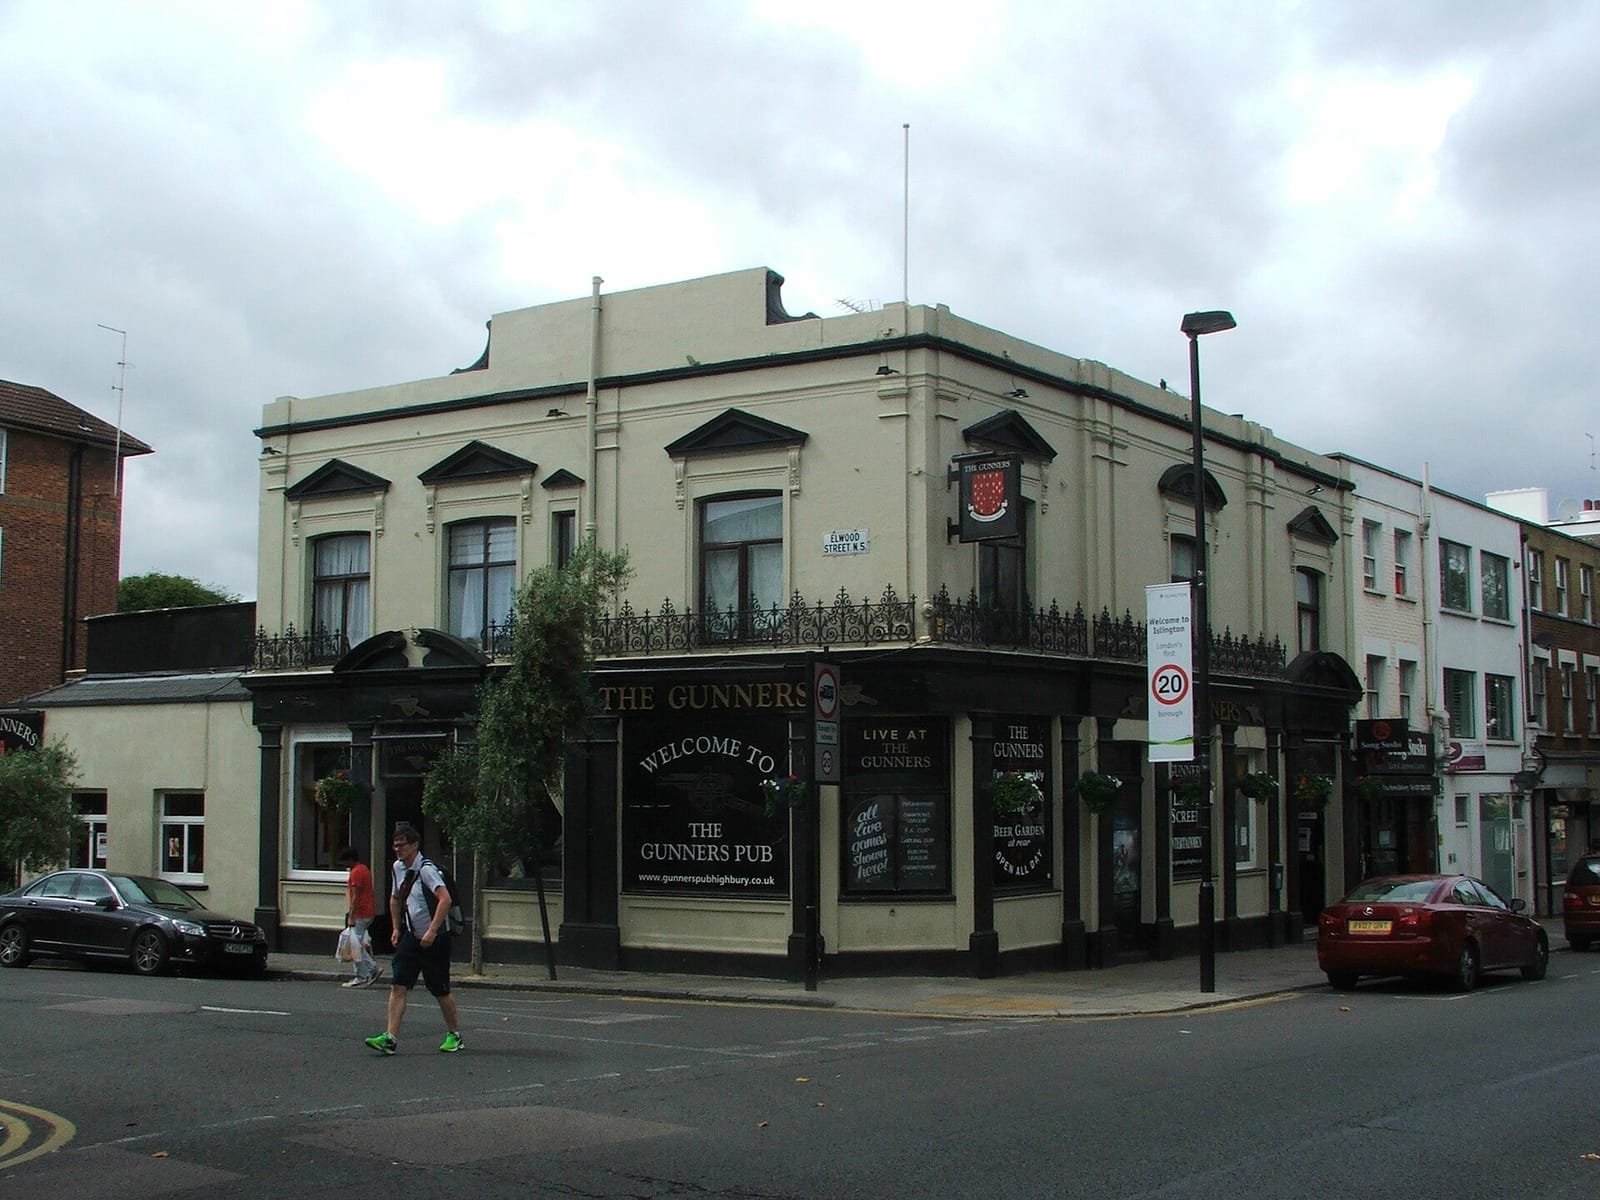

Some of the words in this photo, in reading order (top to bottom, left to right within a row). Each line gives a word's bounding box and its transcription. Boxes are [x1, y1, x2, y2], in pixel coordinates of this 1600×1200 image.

[978, 461, 1010, 471] GUNNERS
[831, 533, 860, 543] ELWOOD
[824, 543, 850, 553] STREET
[1149, 617, 1180, 625] Welcome
[1153, 626, 1184, 636] Islington
[1158, 674, 1182, 694] 20
[599, 686, 656, 711] THE
[667, 682, 807, 710] GUNNERS
[863, 729, 899, 741] LIVE
[908, 729, 928, 741] AT
[1008, 725, 1030, 740] THE
[640, 735, 742, 774] WELCOME
[745, 745, 775, 774] TO
[881, 743, 911, 755] THE
[993, 742, 1045, 758] GUNNERS
[860, 755, 932, 769] GUNNERS
[688, 823, 723, 838] THE
[993, 825, 1013, 838] BEER
[1014, 824, 1044, 837] GARDEN
[851, 832, 888, 855] games
[640, 842, 730, 862] GUNNERS
[733, 844, 774, 863] PUB
[852, 850, 888, 868] shown
[995, 851, 1014, 875] OPEN
[1015, 866, 1030, 876] ALL
[1030, 849, 1043, 869] DAY
[638, 873, 776, 887] www.gunnerspubhighbury.co.uk
